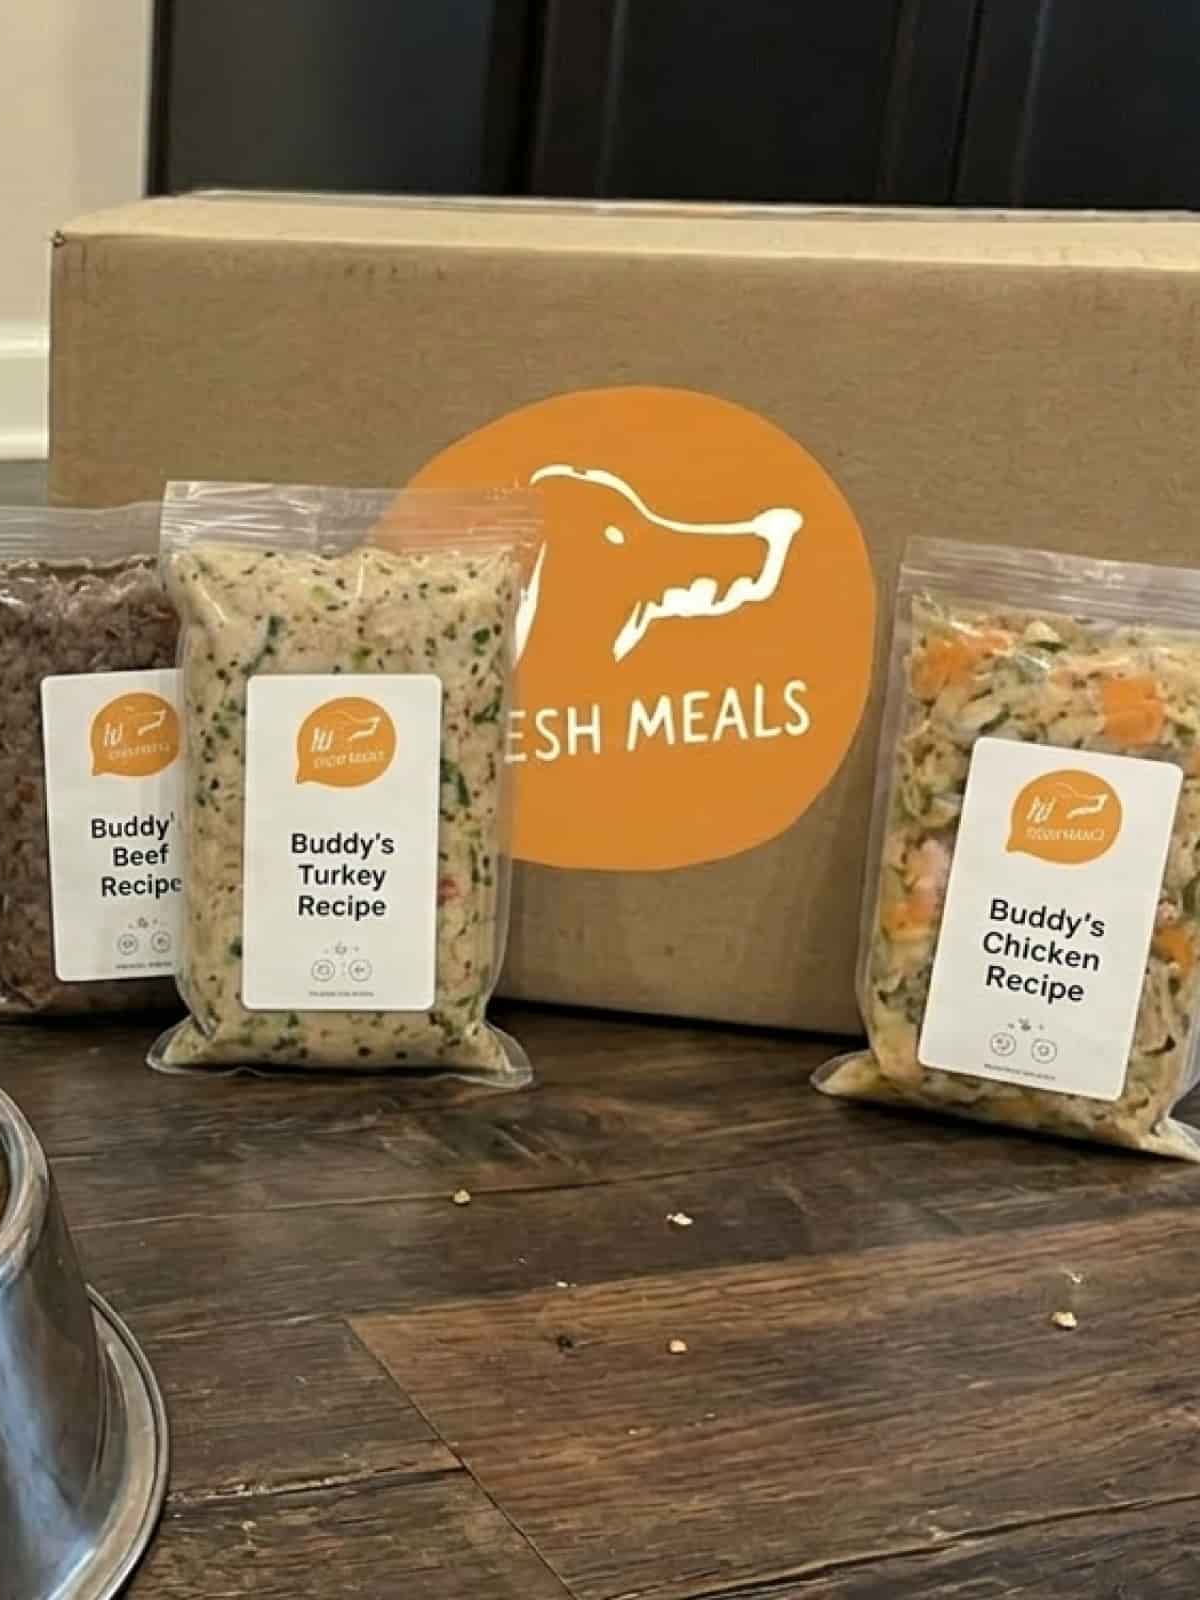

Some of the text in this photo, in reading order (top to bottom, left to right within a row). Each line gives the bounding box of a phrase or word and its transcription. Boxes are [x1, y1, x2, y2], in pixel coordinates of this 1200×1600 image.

[504, 680, 810, 763] ESH MEALS
[91, 811, 177, 840] Buddy'
[113, 844, 169, 866] Beef
[291, 833, 395, 860] Buddy's
[298, 864, 386, 890] Turkey
[298, 895, 386, 920] Recipe
[990, 898, 1105, 938] Buddy's
[983, 932, 1100, 970] Chicken
[986, 965, 1085, 1004] Recipe
